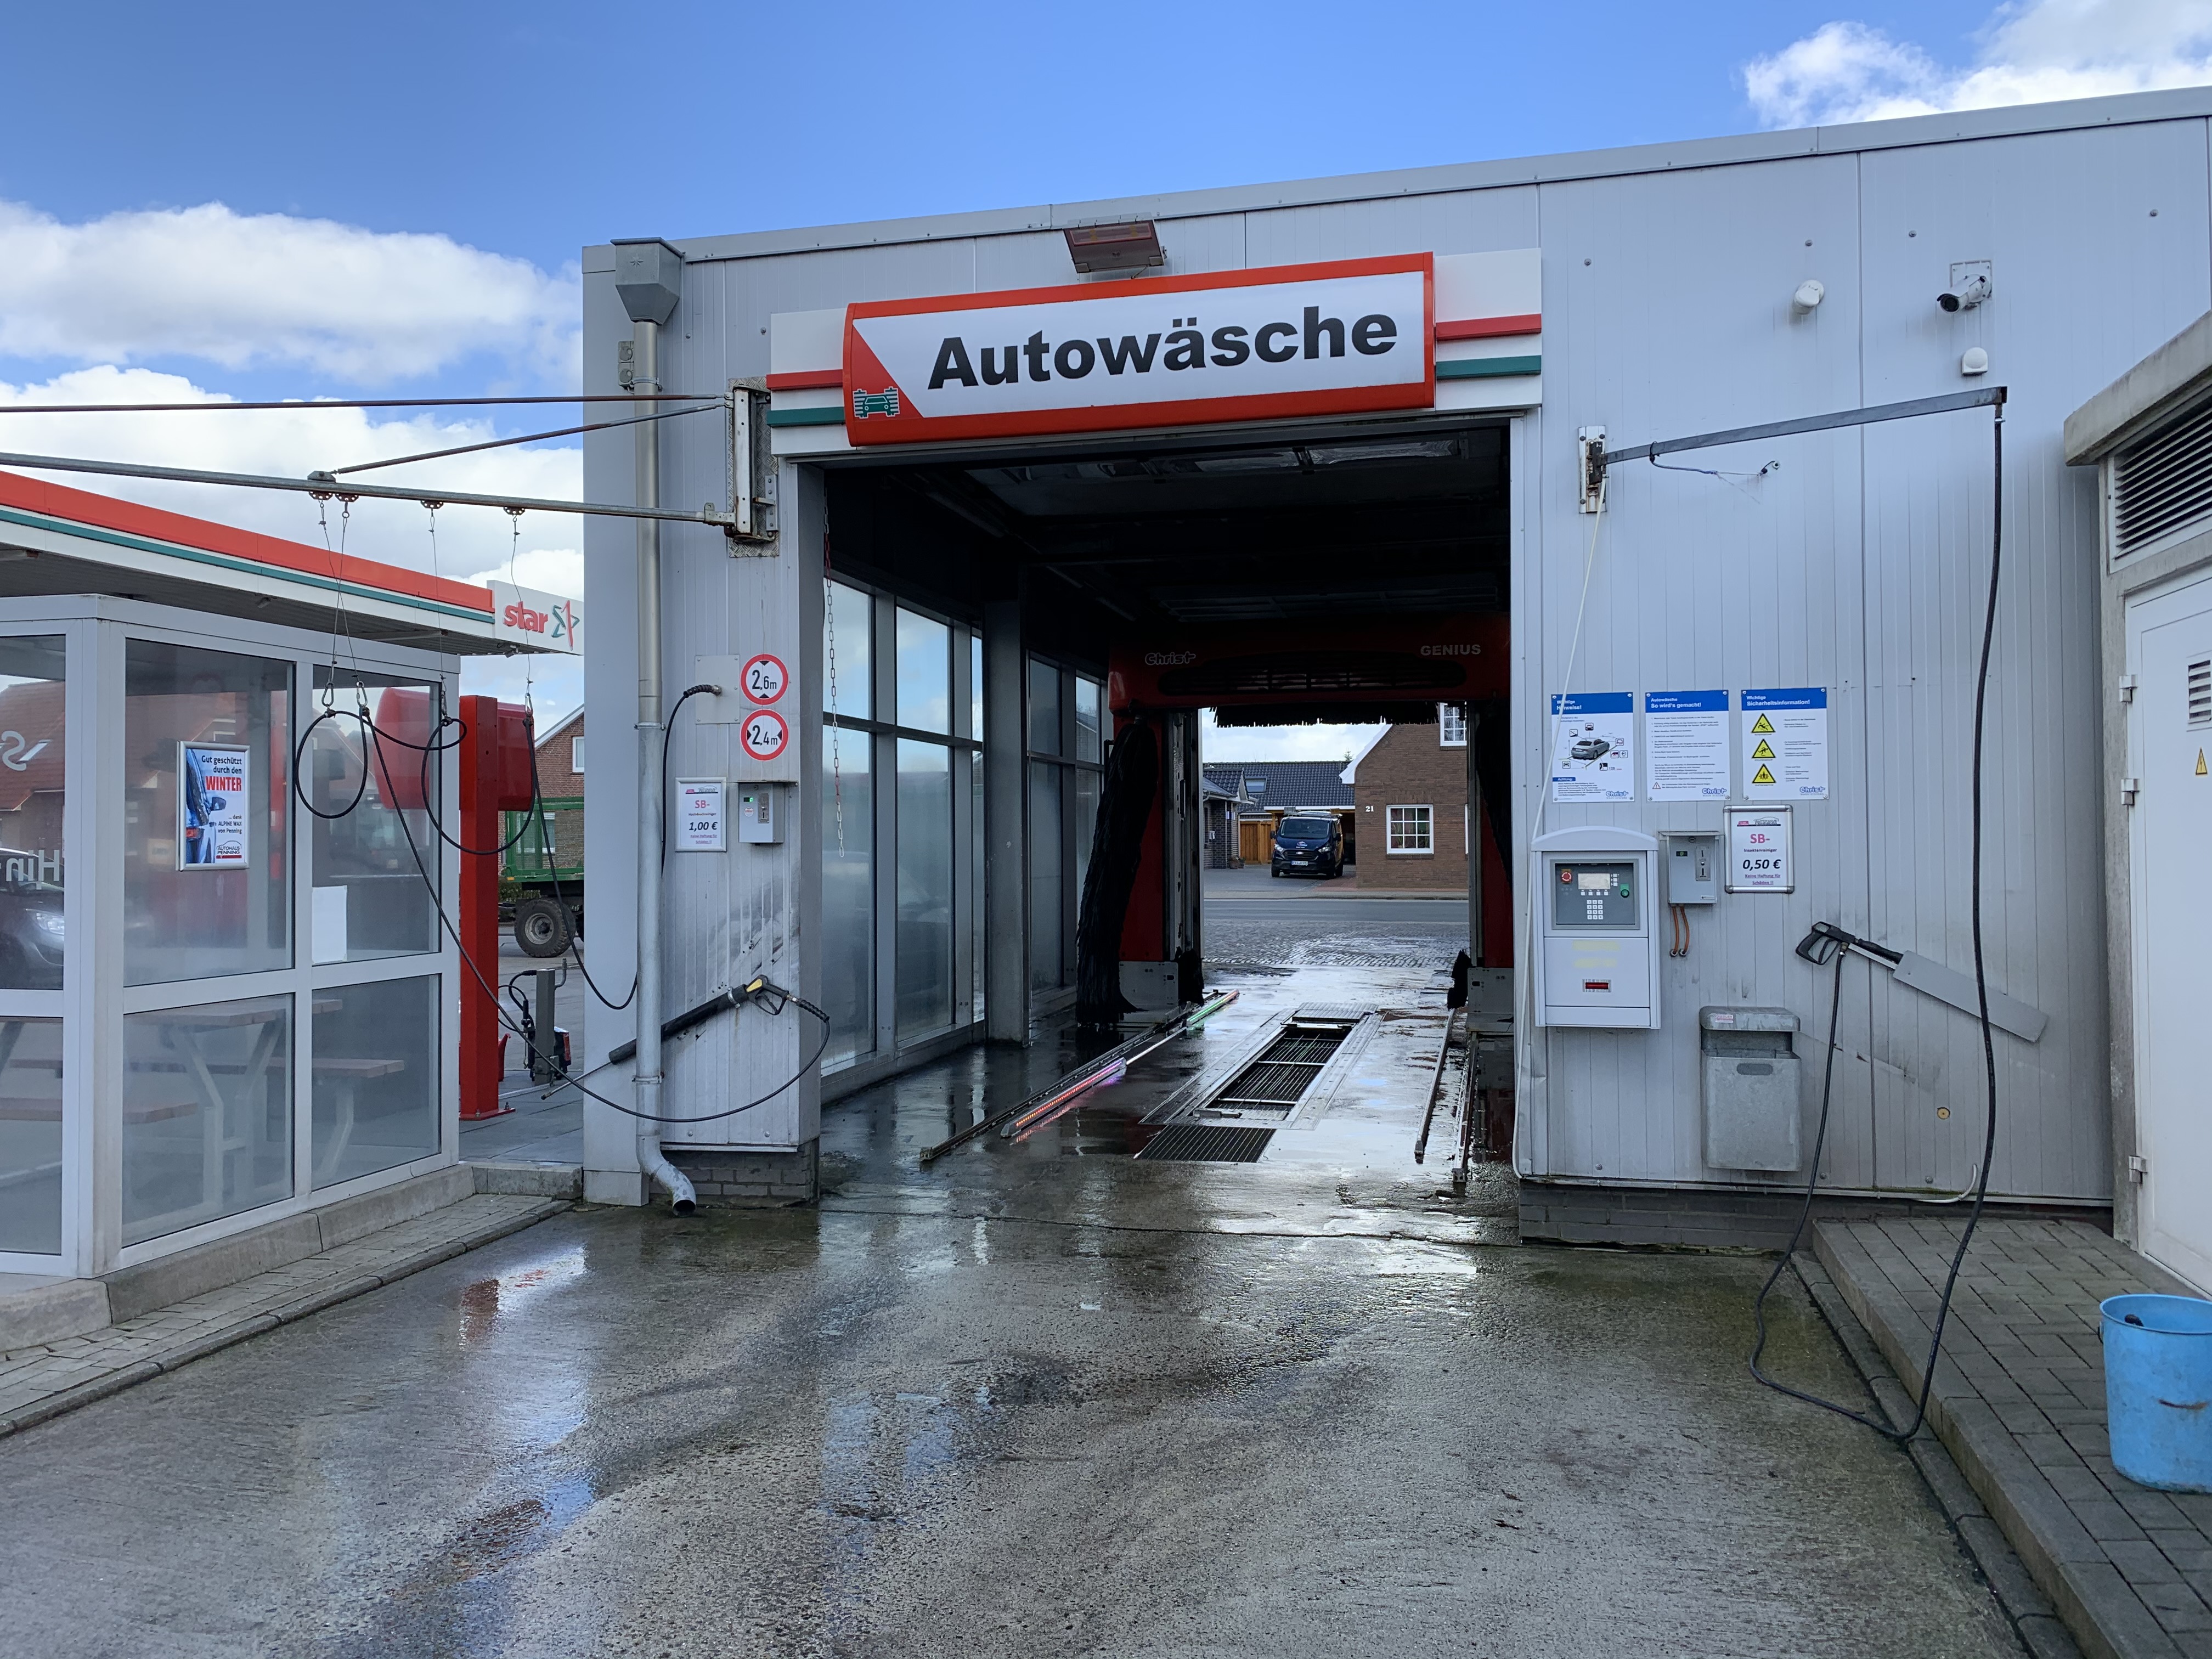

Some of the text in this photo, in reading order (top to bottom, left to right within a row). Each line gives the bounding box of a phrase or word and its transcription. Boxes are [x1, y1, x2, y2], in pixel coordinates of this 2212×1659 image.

[928, 306, 1397, 390] Autowäsche
[504, 601, 548, 633] star
[1420, 644, 1481, 656] GENIUS
[1145, 651, 1196, 665] Christ
[201, 755, 242, 765] Gut geschützt
[213, 765, 242, 774] durch den
[206, 776, 242, 792] WINTER
[695, 800, 710, 809] SB-
[689, 821, 718, 832] 1,00 €
[1750, 833, 1770, 844] SB-
[1742, 859, 1781, 871] 0,50 €
